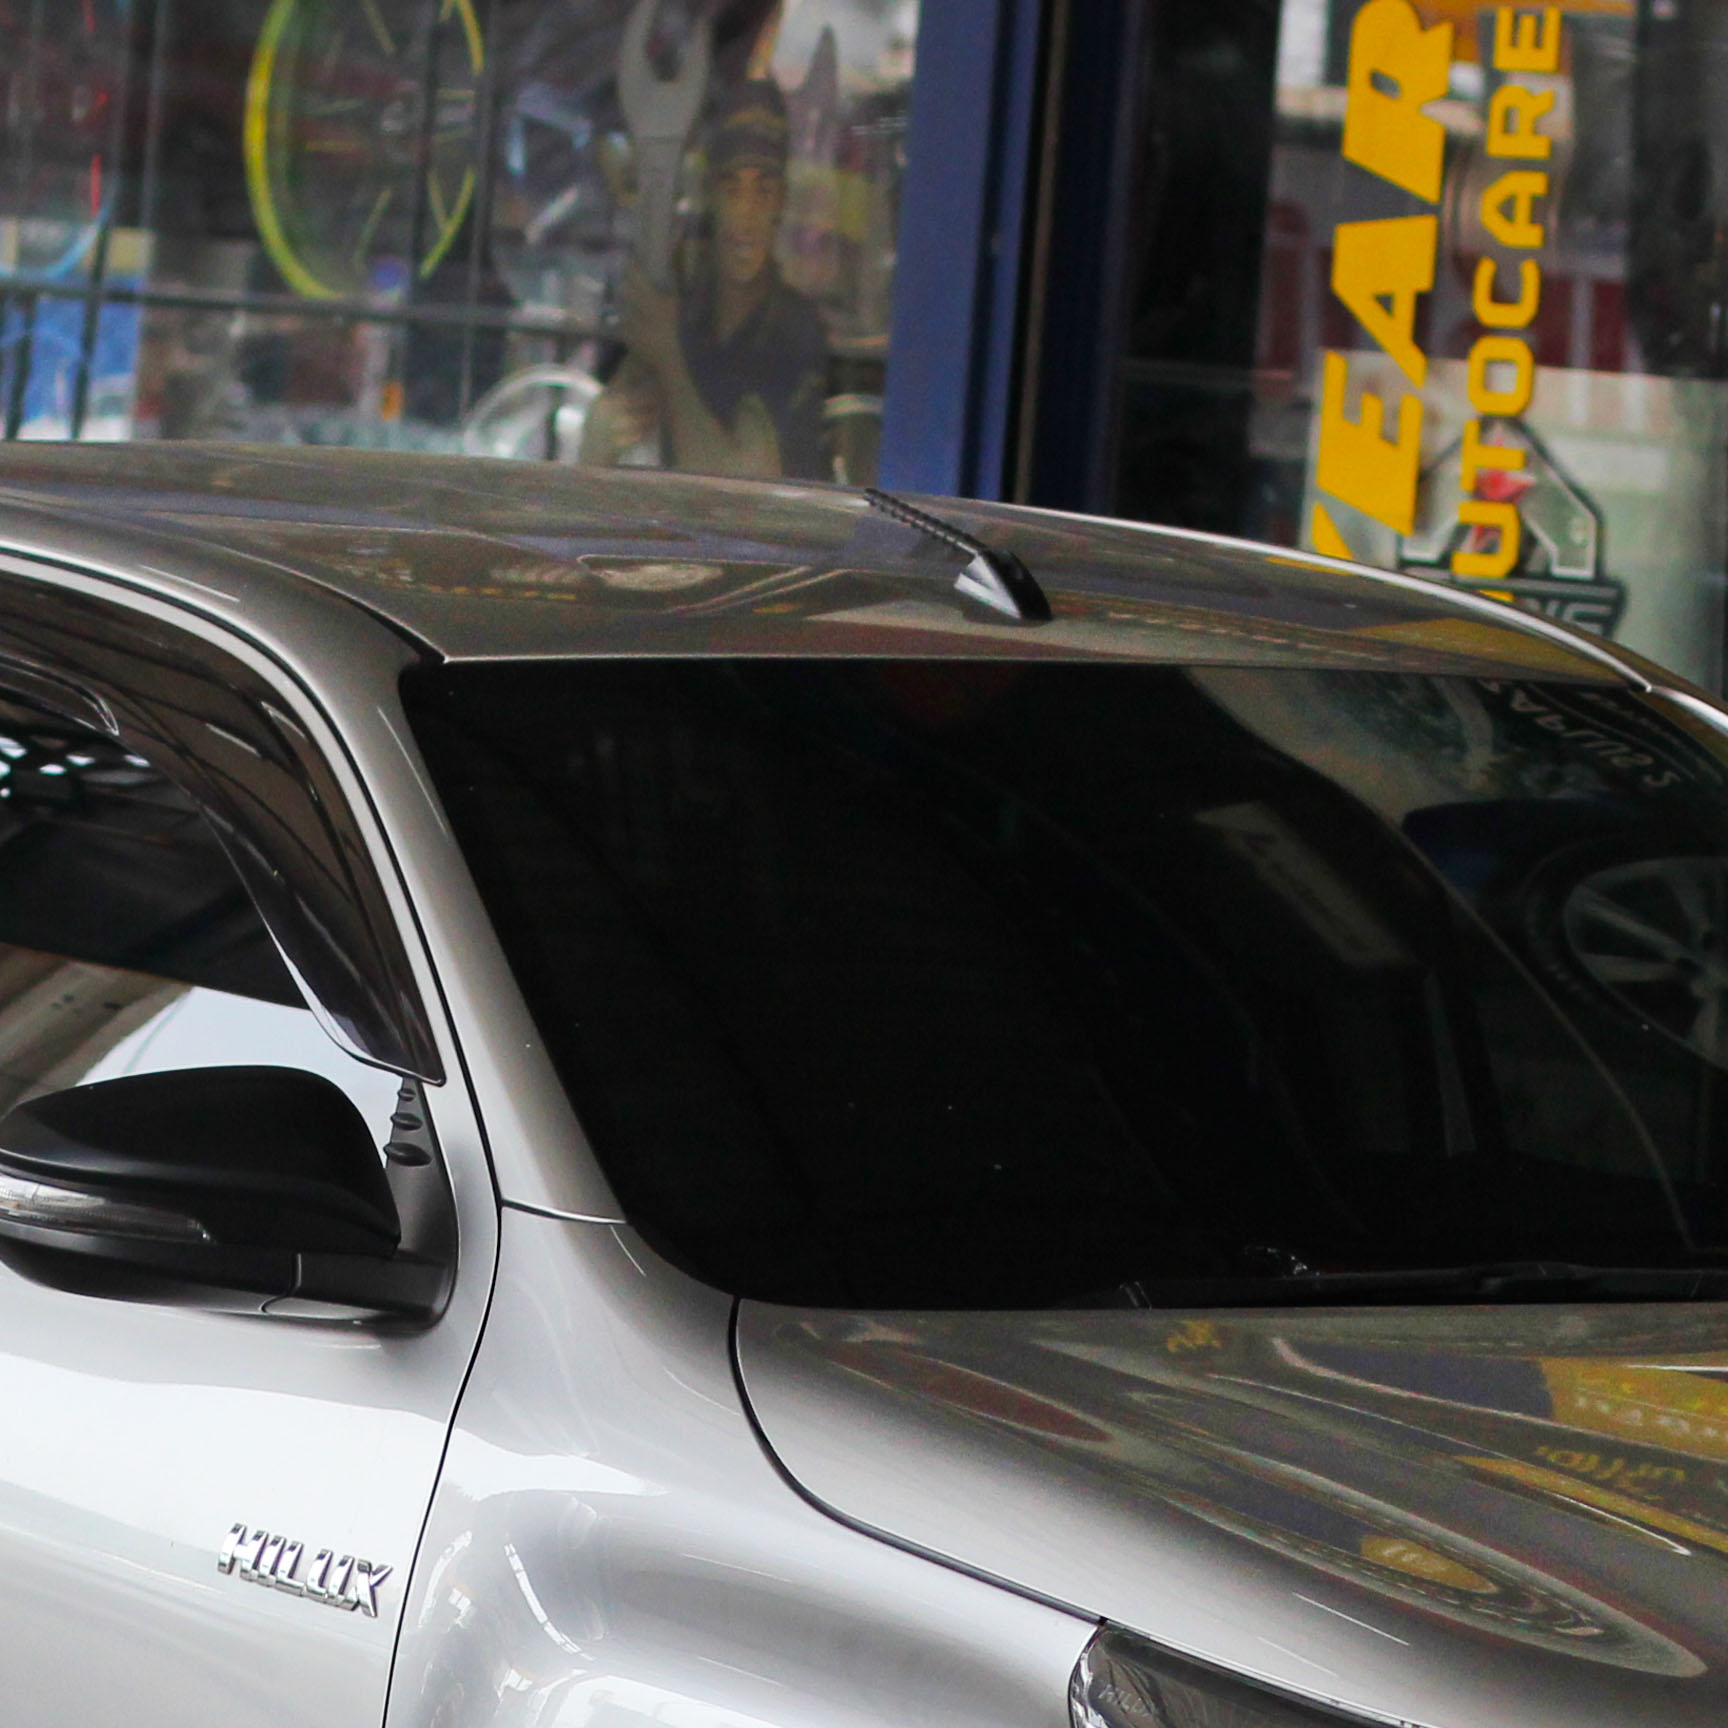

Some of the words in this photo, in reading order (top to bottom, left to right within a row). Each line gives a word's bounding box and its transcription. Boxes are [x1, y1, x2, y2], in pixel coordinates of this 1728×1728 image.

[1311, 0, 1454, 560] EAR
[1450, 6, 1563, 602] UTOCARE
[216, 1522, 394, 1619] HILUX
